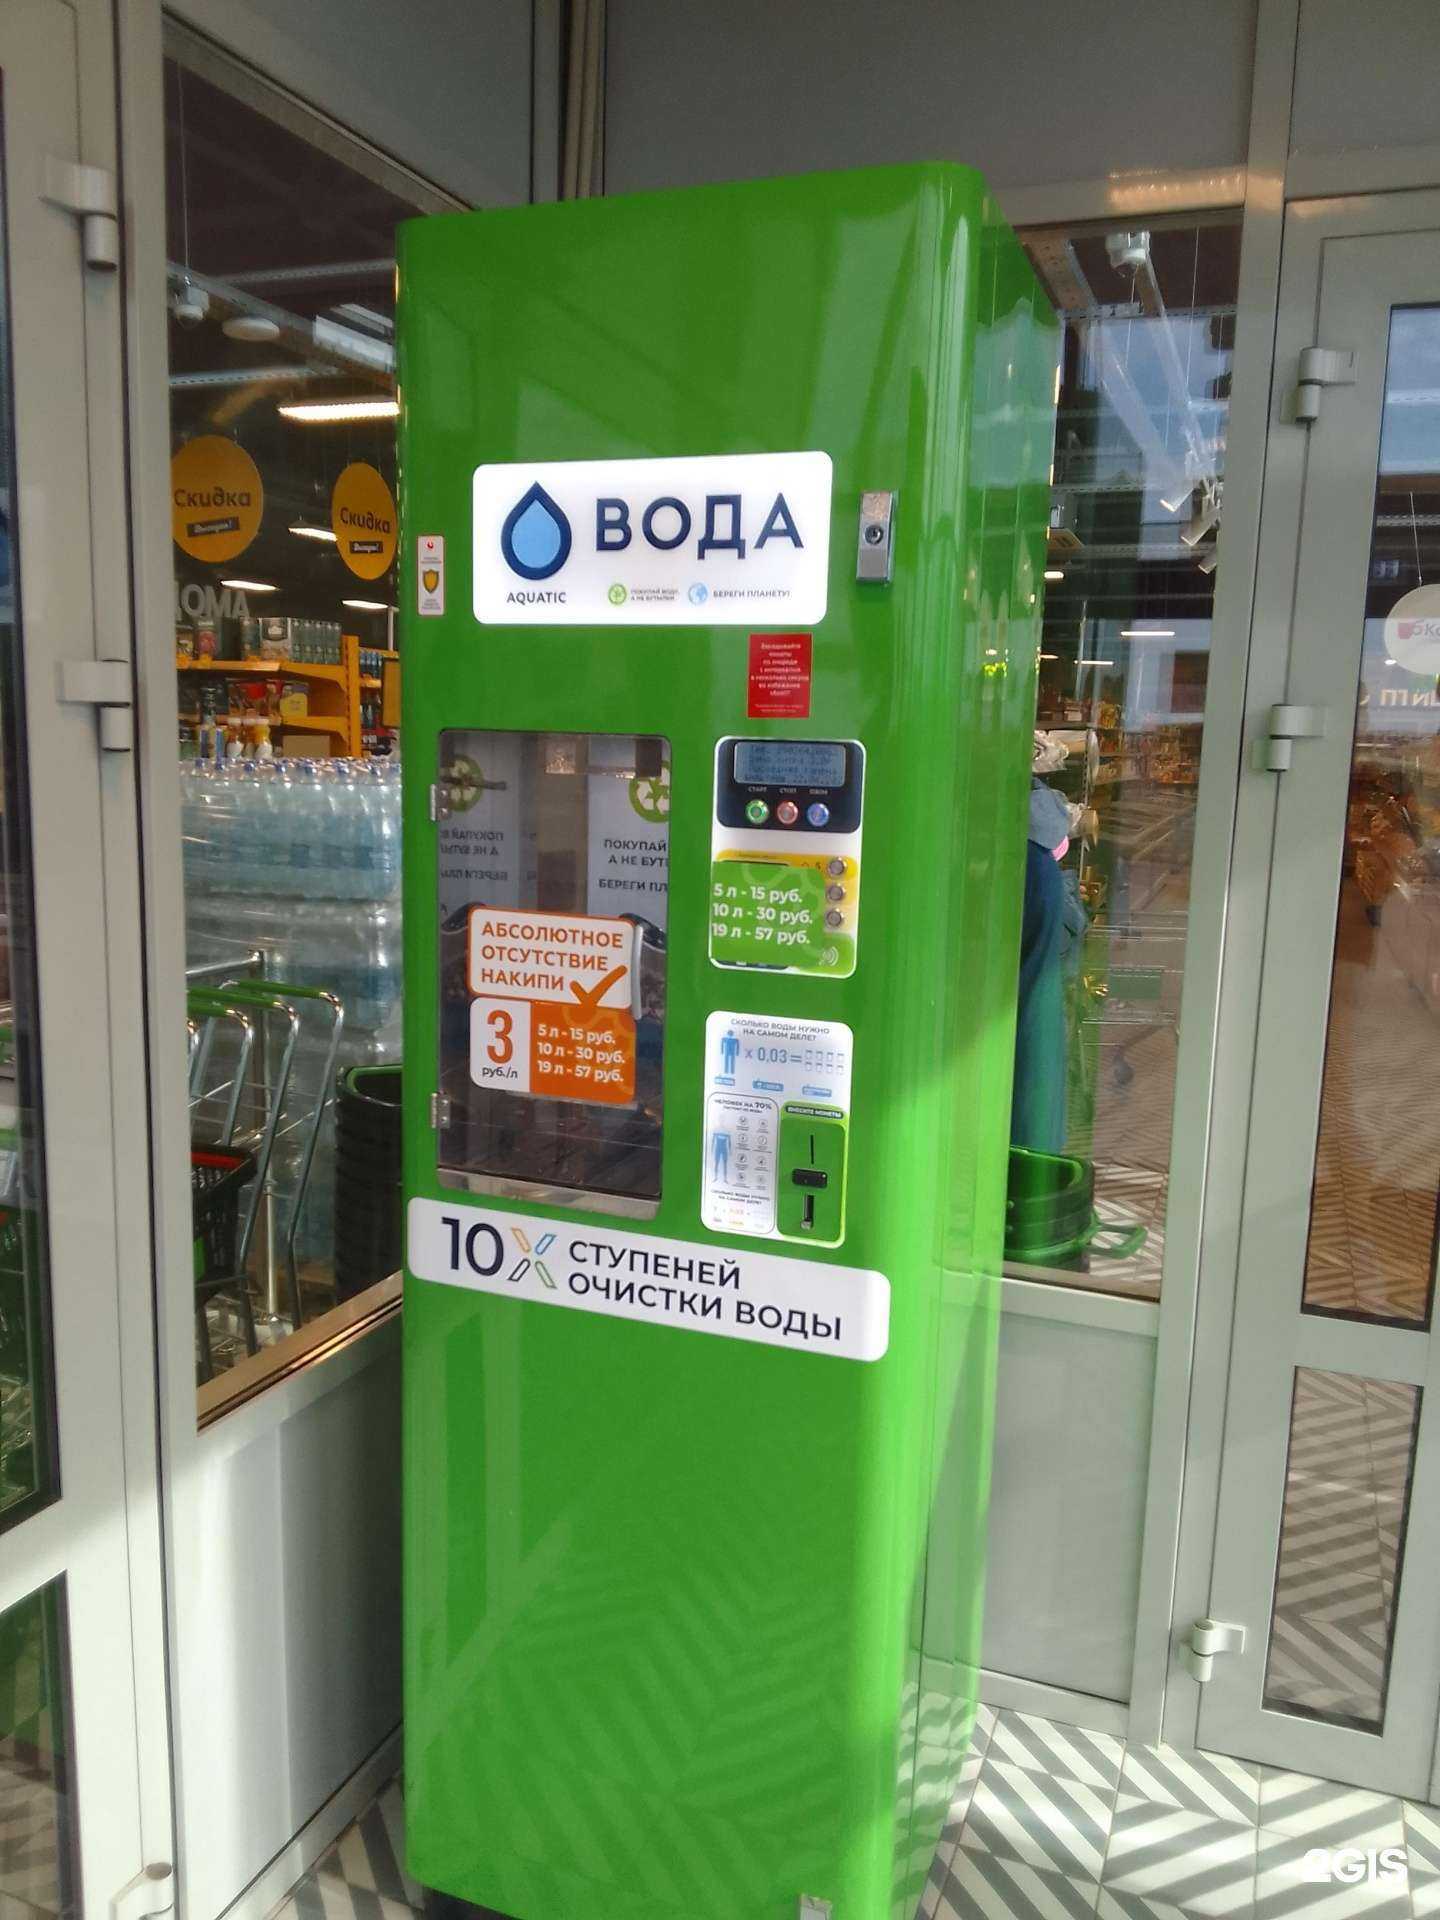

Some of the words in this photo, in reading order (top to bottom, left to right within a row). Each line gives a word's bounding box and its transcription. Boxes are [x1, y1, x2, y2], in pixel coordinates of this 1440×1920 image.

[174, 486, 251, 507] Скидка
[340, 506, 390, 534] Скидка
[596, 492, 804, 560] ВОДА
[507, 591, 566, 605] AQUATIC
[713, 589, 745, 598] БЕРЕГИ
[604, 839, 666, 852] ПОКУПАЙ
[608, 855, 617, 864] А
[621, 856, 638, 865] НЕ
[599, 879, 645, 890] БЕРЕГИ
[713, 883, 723, 896] 5
[727, 886, 737, 898] л
[750, 886, 765, 900] 15
[769, 889, 802, 904] руб.
[713, 903, 728, 916] 10
[733, 907, 743, 918] л
[756, 906, 776, 920] 30
[780, 909, 813, 925] руб.
[482, 921, 623, 949] АБСОЛЮТНОЕ
[712, 923, 727, 937] 19
[731, 927, 741, 938] л
[755, 926, 773, 940] 57
[777, 930, 810, 946] руб.
[481, 945, 608, 971] ОТСУТСТВИЕ
[481, 968, 564, 991] НАКИПИ
[487, 1009, 513, 1064] 3
[538, 1024, 546, 1036] 5
[549, 1028, 558, 1038] л
[570, 1027, 583, 1039] 15
[586, 1030, 615, 1045] руб.
[731, 1018, 769, 1028] СКОЛЬКО
[771, 1022, 796, 1031] ВОДЫ
[799, 1025, 830, 1034] НУЖНО
[743, 1028, 755, 1036] НА
[756, 1030, 788, 1039] САМОМ
[537, 1042, 552, 1055] 10
[555, 1046, 565, 1056] л
[576, 1047, 592, 1059] 30
[596, 1048, 625, 1064] руб.
[482, 1066, 518, 1079] руб./л
[537, 1060, 552, 1073] 19
[554, 1064, 563, 1074] л
[575, 1065, 591, 1077] 57
[594, 1066, 624, 1083] руб.
[755, 1101, 772, 1110] 70%
[569, 1239, 740, 1290] СТУПЕНЕЙ
[568, 1272, 722, 1321] ОЧИСТКИ
[735, 1301, 841, 1341] ВОДЫ
